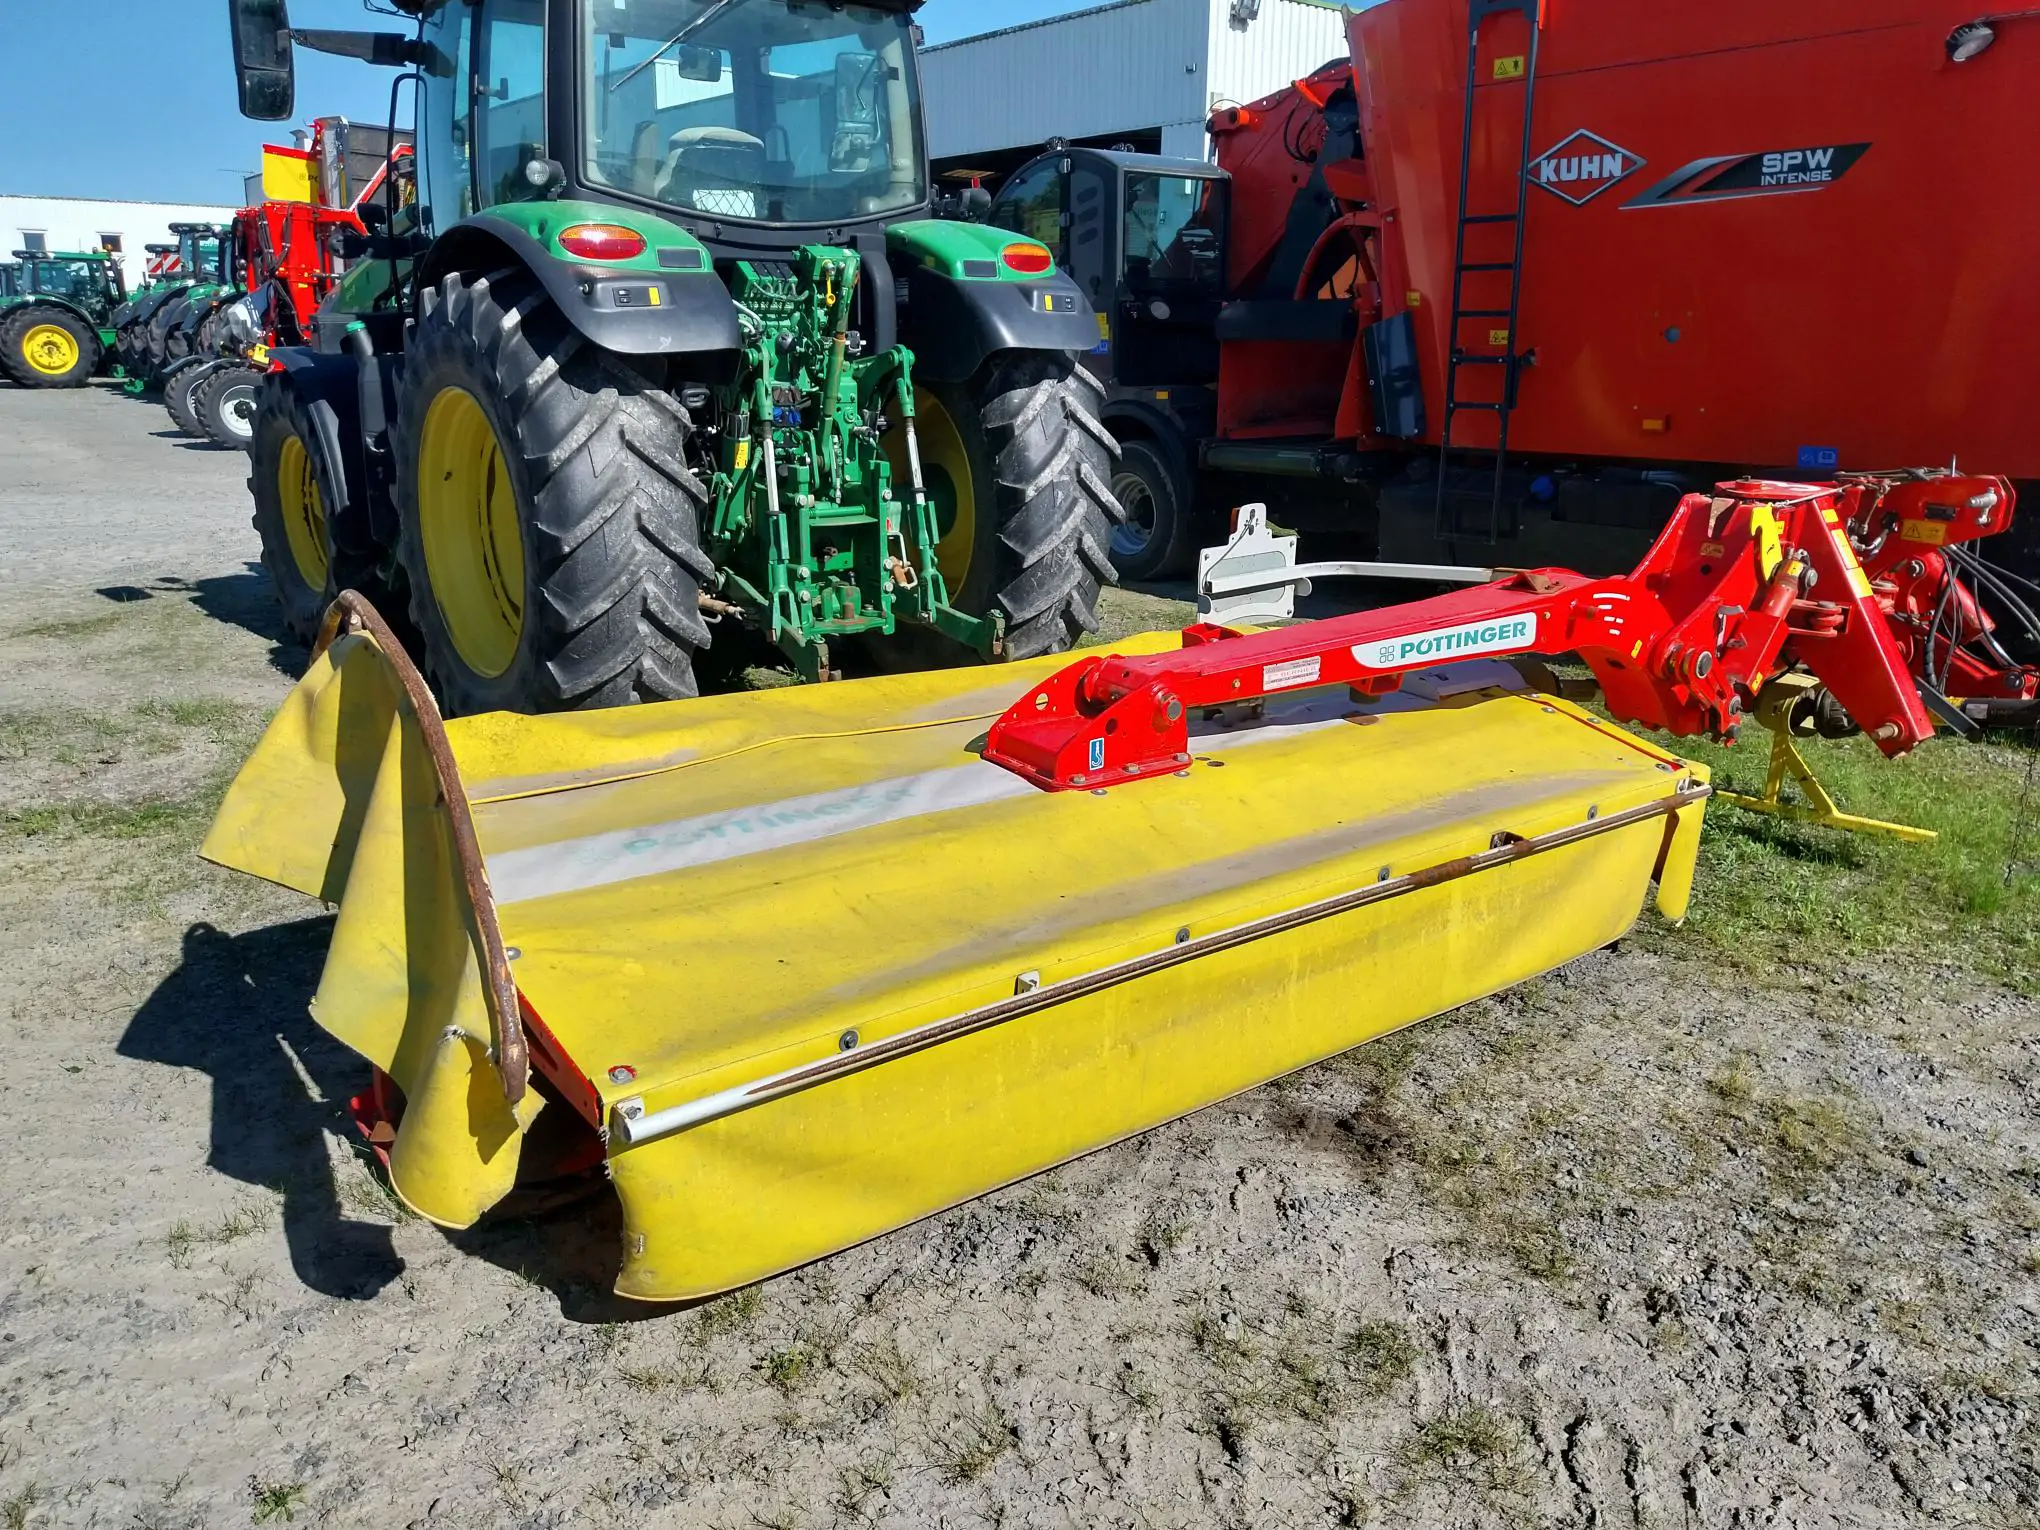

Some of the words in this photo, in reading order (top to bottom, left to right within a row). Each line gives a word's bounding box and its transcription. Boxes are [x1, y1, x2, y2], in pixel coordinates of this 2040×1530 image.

[1539, 153, 1623, 183] KUHN
[1761, 148, 1834, 174] SPW
[1760, 170, 1832, 186] INTENSE
[1400, 621, 1527, 659] PÖTTINGER
